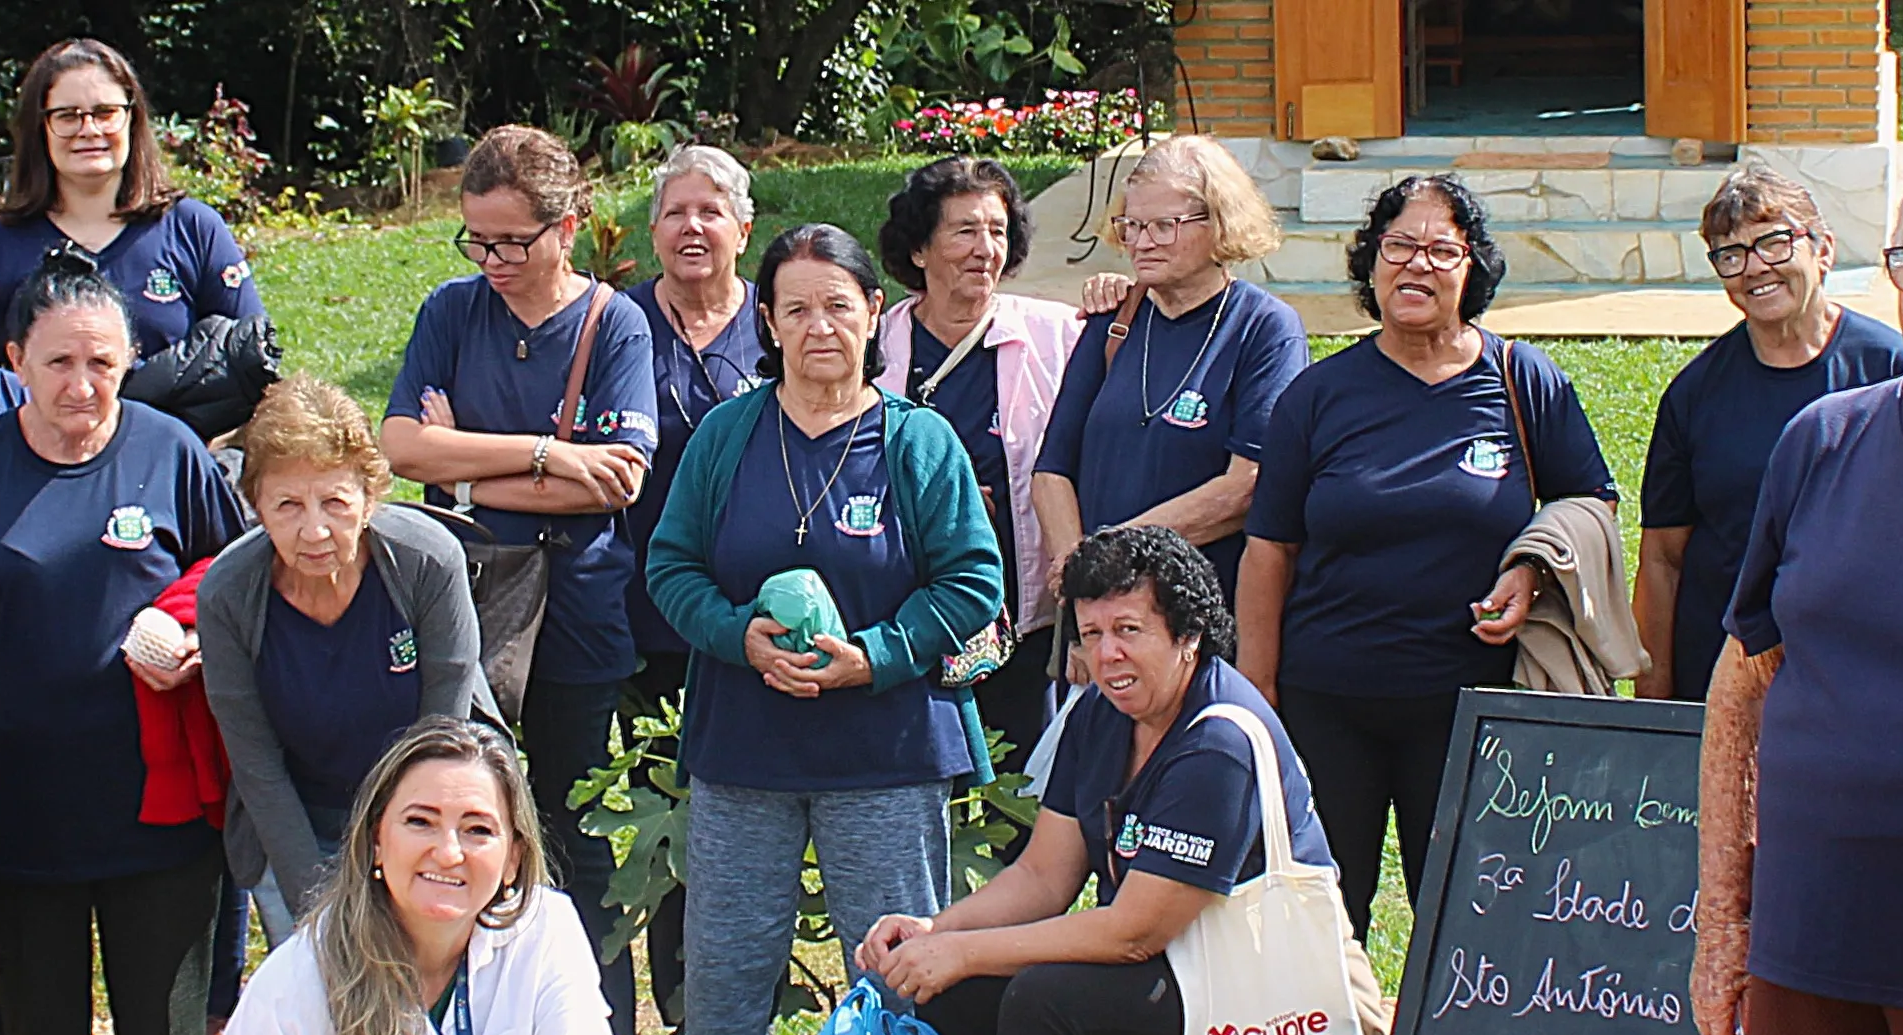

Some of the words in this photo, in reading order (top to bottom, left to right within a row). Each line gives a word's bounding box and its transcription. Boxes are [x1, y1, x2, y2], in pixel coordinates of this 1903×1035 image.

[1476, 736, 1613, 853] "Sejam
[1144, 832, 1212, 861] JARDIM
[1188, 834, 1215, 847] NOVO
[1532, 858, 1649, 929] Idade
[1668, 890, 1698, 933] d
[1433, 948, 1510, 1019] Sto
[1512, 957, 1681, 1024] Antônio
